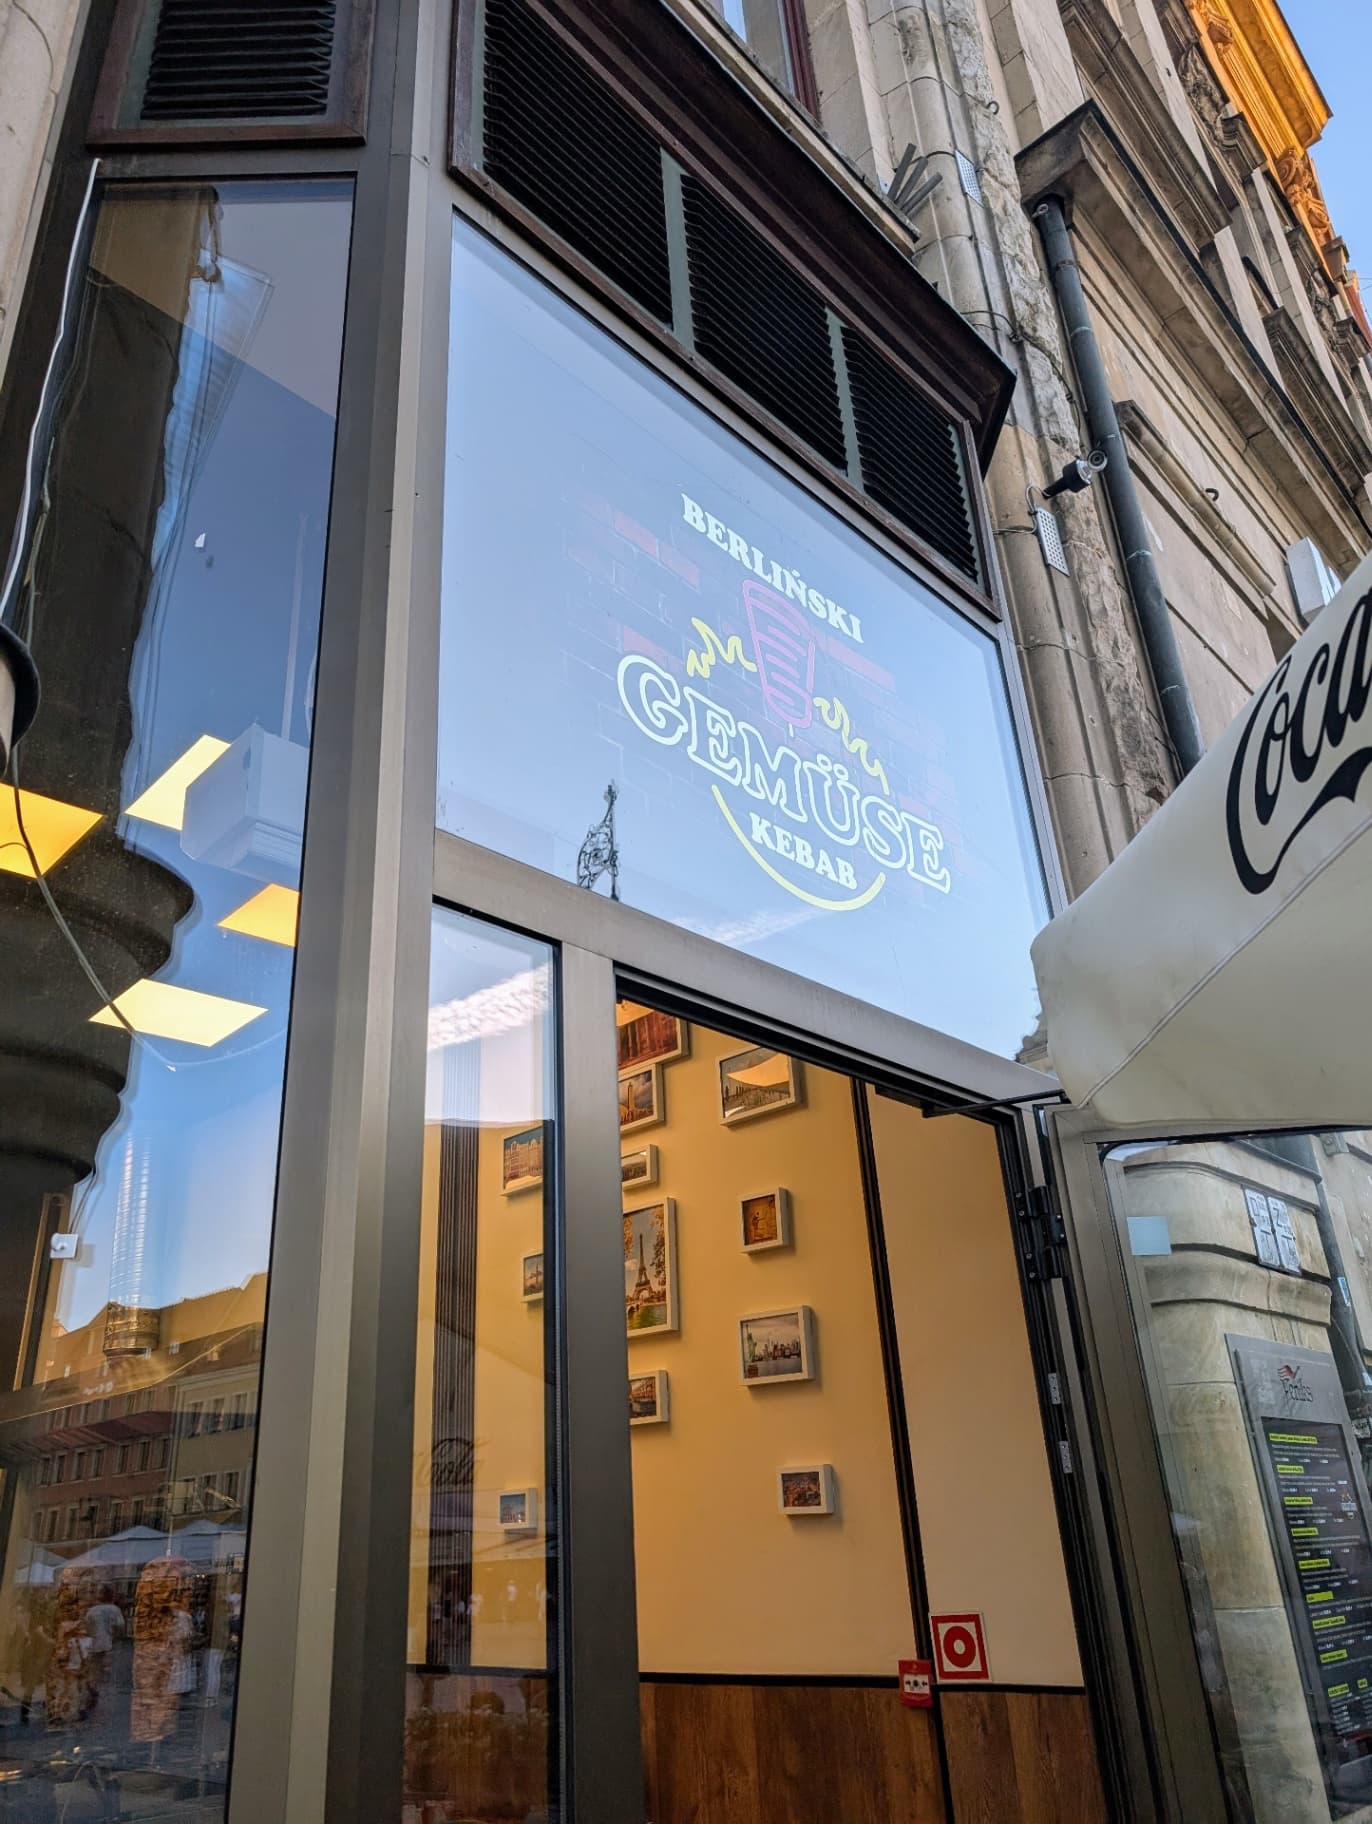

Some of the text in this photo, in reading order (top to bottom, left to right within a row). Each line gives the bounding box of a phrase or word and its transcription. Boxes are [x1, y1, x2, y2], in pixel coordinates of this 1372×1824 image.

[681, 494, 864, 643] BERLIŃSKI
[617, 655, 951, 893] GEMÜSE
[749, 813, 857, 889] KEBAB
